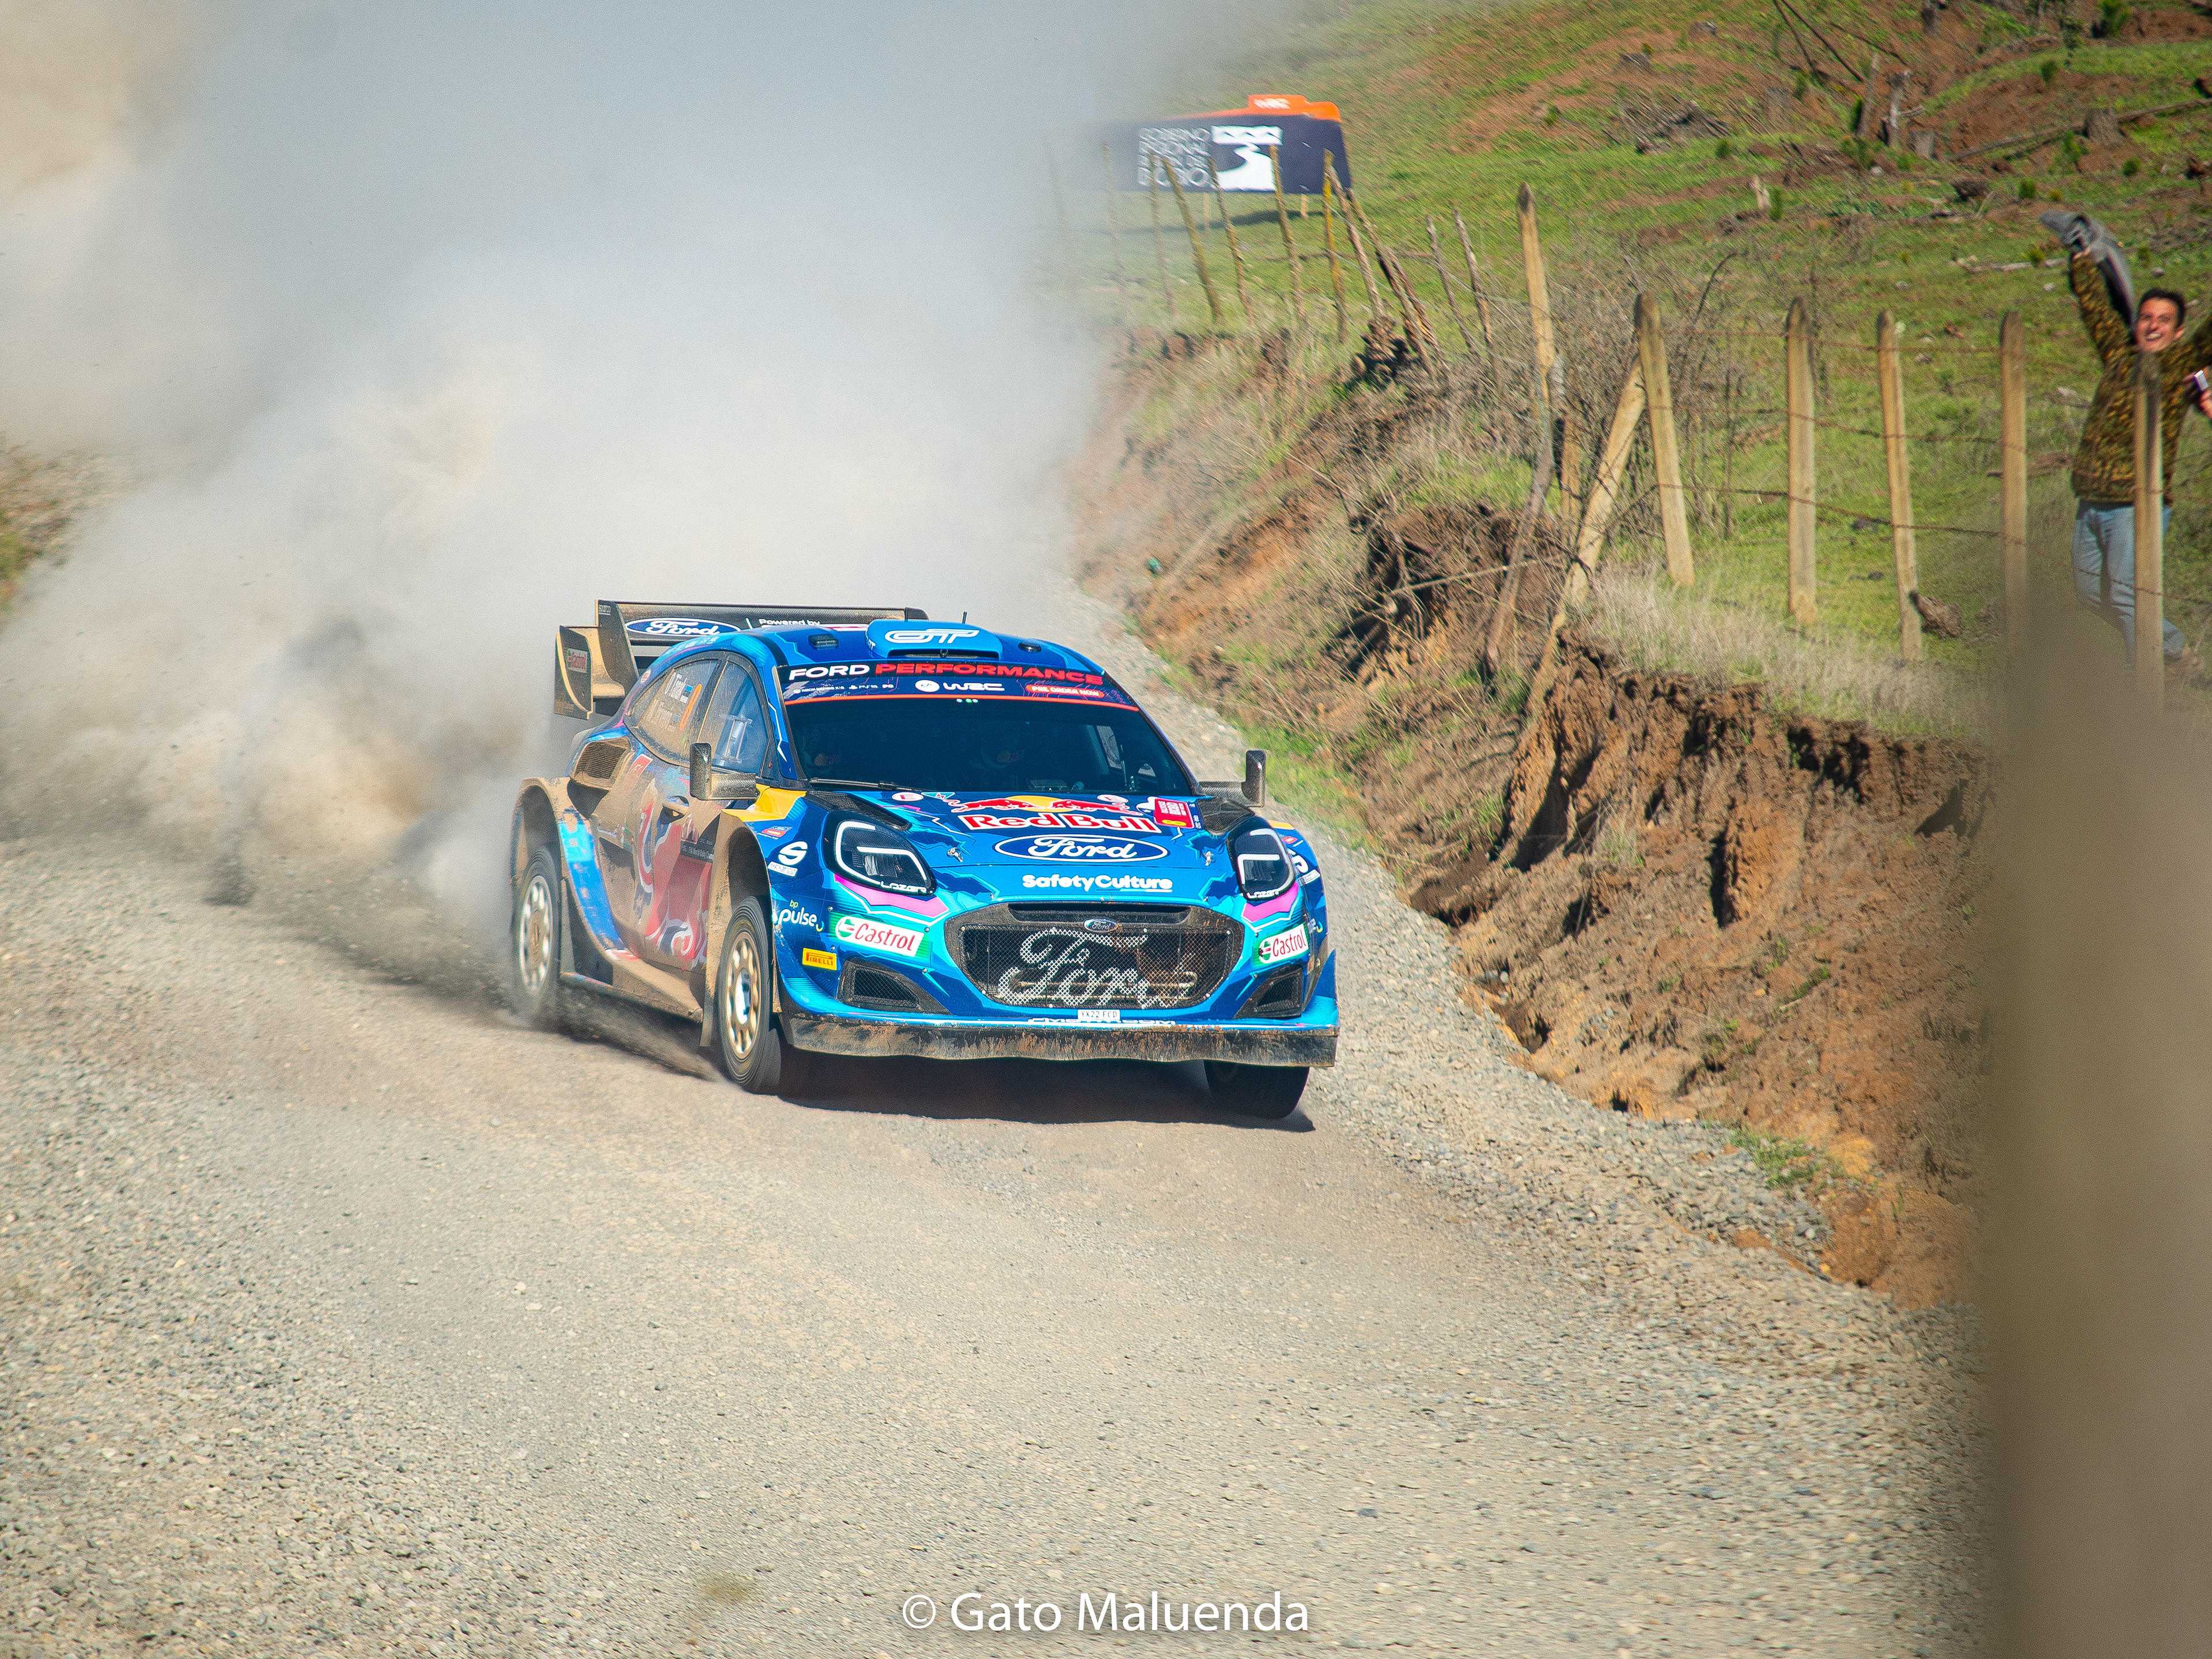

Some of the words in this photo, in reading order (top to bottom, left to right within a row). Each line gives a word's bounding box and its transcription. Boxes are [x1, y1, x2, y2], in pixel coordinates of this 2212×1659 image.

[646, 620, 720, 635] Ford
[789, 664, 870, 680] FORD
[875, 663, 1104, 685] PERFORMANCE
[942, 682, 1005, 691] WRC
[963, 812, 1060, 828] Red
[1067, 813, 1157, 831] Bull
[1028, 836, 1138, 858] Ford
[771, 863, 796, 873] sparco
[1022, 874, 1173, 891] SafetyCulture
[789, 899, 798, 909] bp
[778, 907, 817, 927] pulse
[1092, 921, 1112, 930] Ford
[855, 923, 915, 951] Castrol
[1272, 929, 1306, 957] Castrol
[806, 952, 834, 966] PIRELLI
[998, 929, 1198, 1009] Ford
